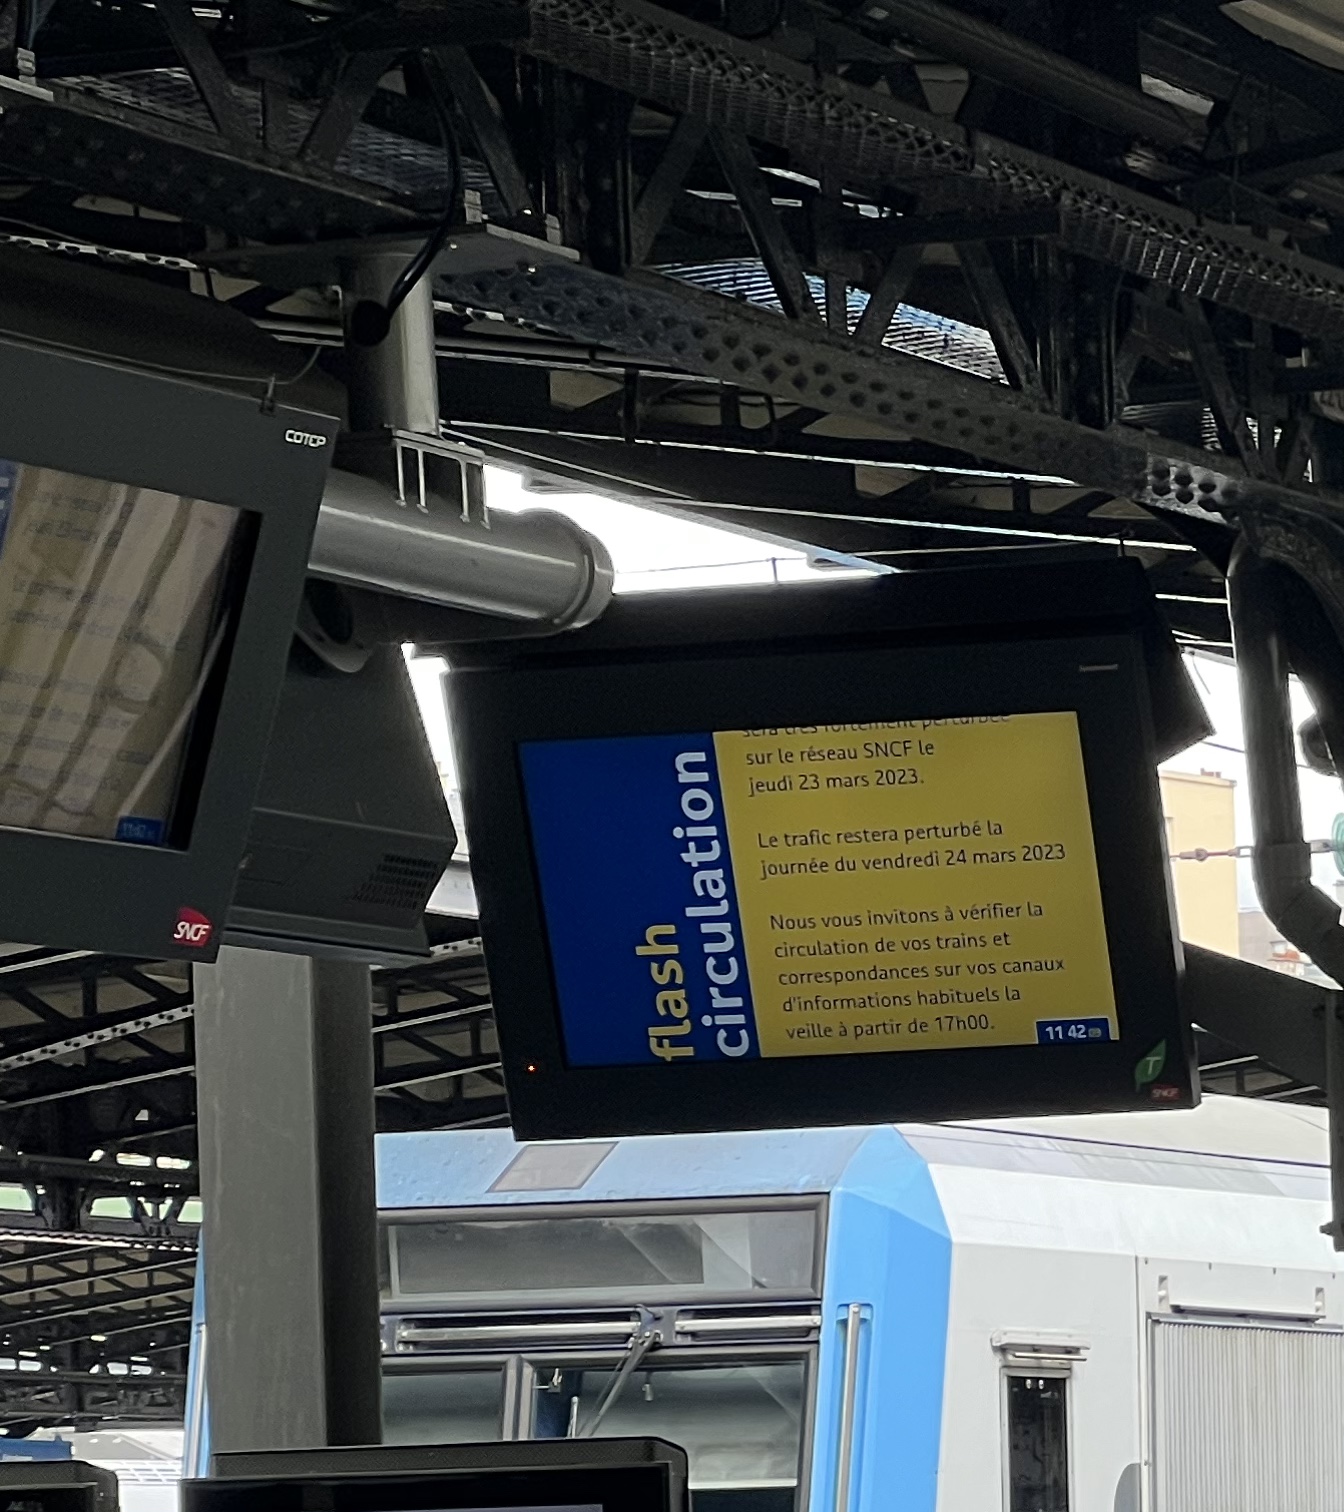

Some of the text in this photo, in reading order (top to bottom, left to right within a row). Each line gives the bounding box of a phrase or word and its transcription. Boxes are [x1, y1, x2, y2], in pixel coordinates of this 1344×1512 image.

[746, 739, 934, 766] sur le réseau SNCF le
[748, 768, 925, 798] jeudi 23 mars 2023.
[757, 819, 1003, 849] Le trafic restera perturbé la
[760, 843, 1066, 881] journée du vendredi 24 mars 2023
[673, 751, 752, 1057] circulation
[769, 901, 1043, 930] Nous vous invitons à vérifier la
[173, 921, 211, 942] SNCF
[774, 931, 1012, 958] circulation de vos trains et
[778, 959, 1065, 986] correspondances sur vos canaux
[636, 925, 694, 1061] flash
[782, 985, 1021, 1012] d'informations habituels la
[785, 1013, 995, 1041] veille à partir de 17h00.
